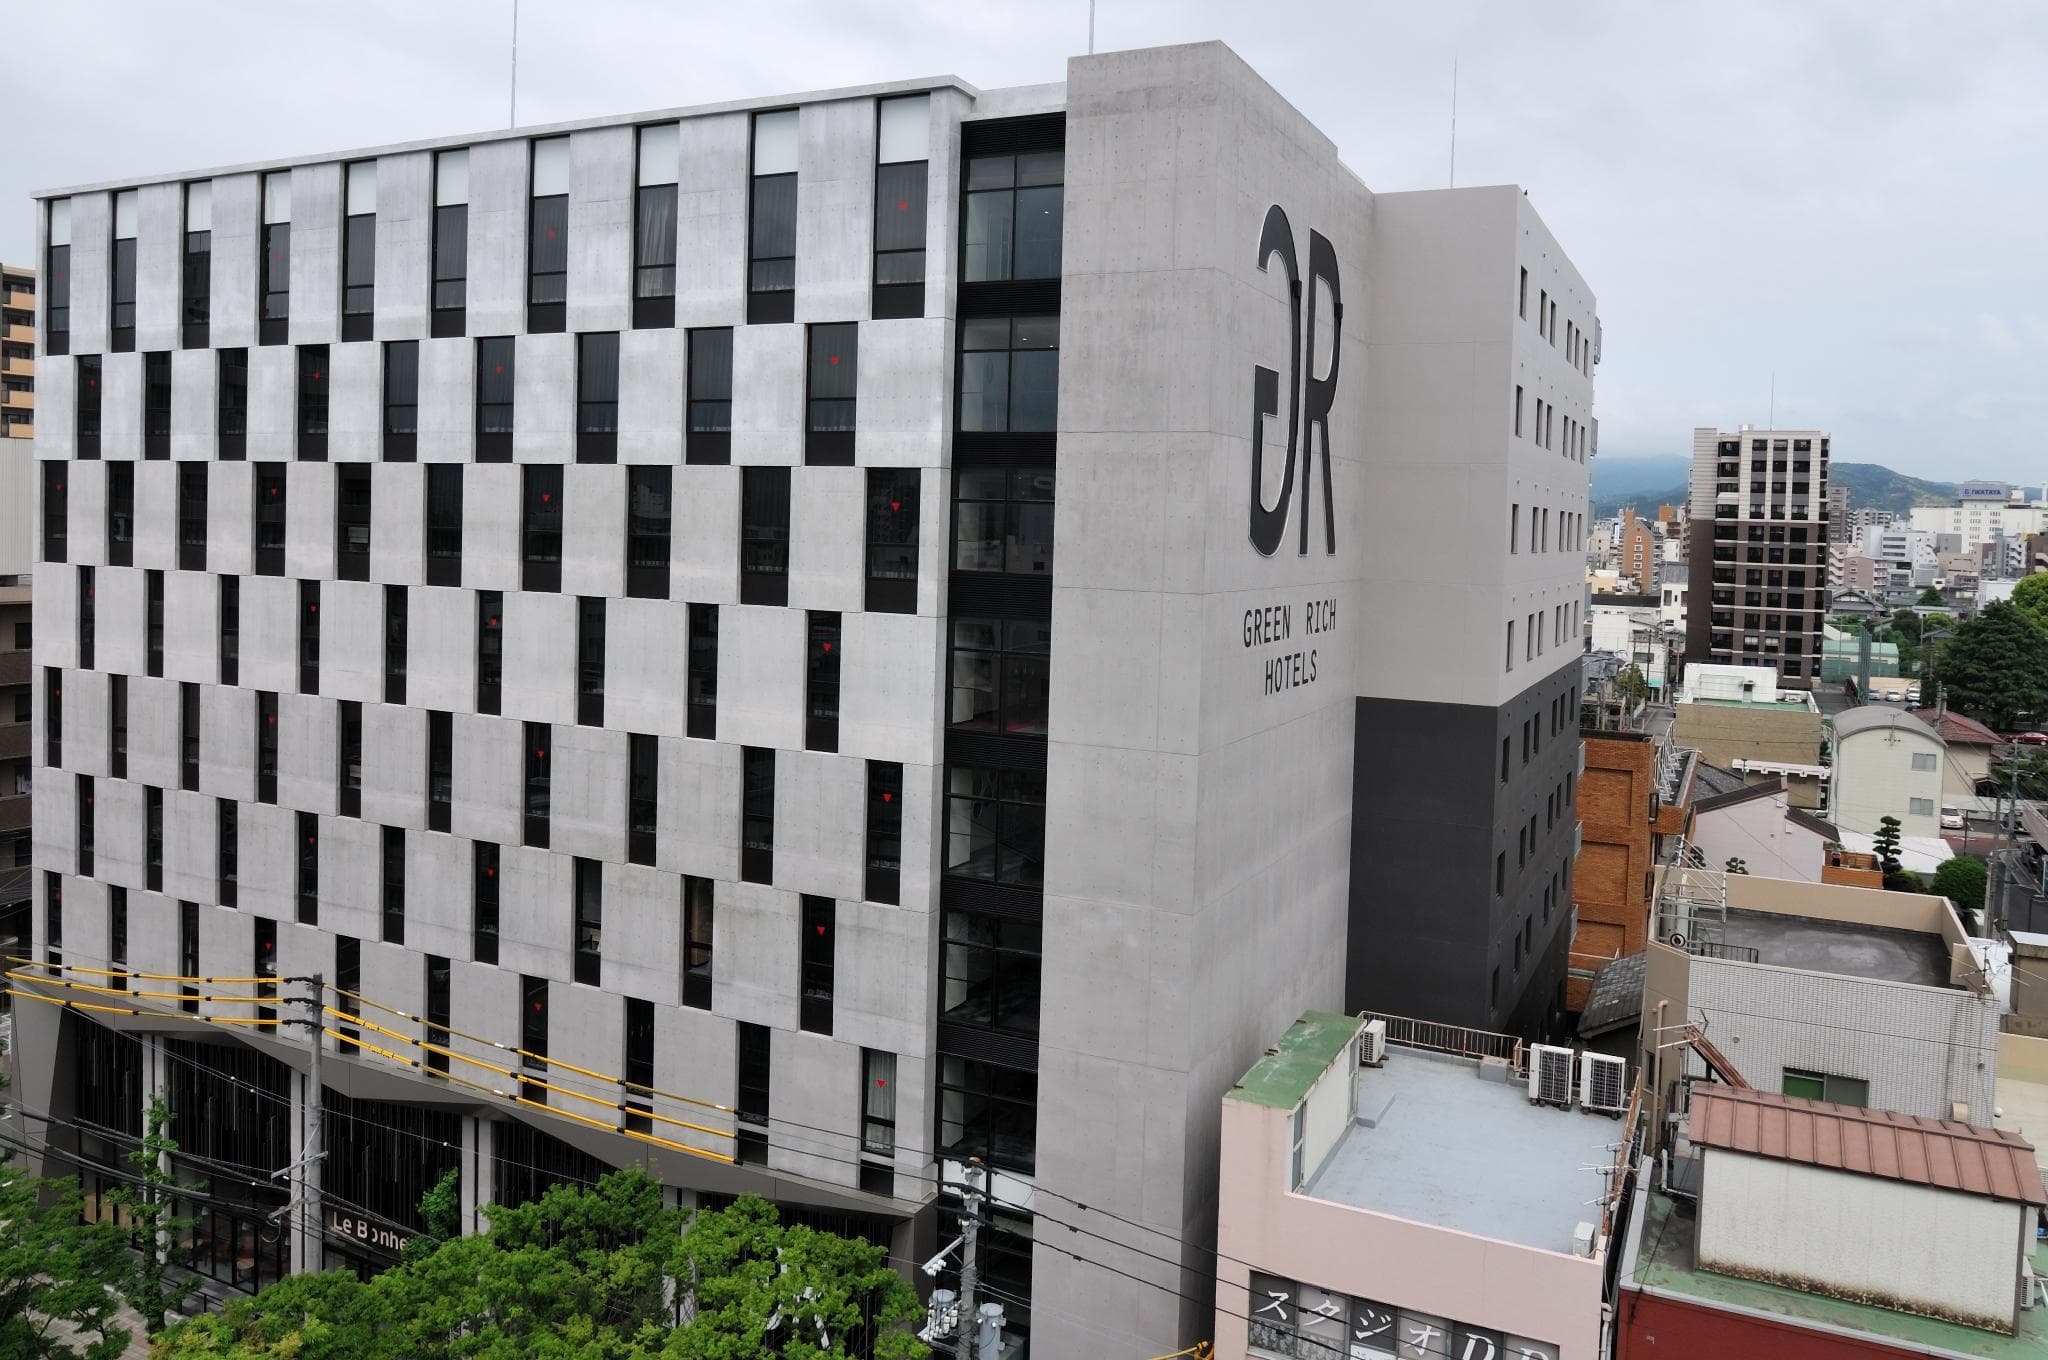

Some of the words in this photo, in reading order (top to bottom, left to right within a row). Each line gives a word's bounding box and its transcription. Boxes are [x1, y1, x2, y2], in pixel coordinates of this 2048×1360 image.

[1243, 605, 1290, 648] GREEN
[1306, 598, 1336, 635] RICH
[1265, 649, 1317, 696] HOTELS
[332, 1211, 352, 1234] Le
